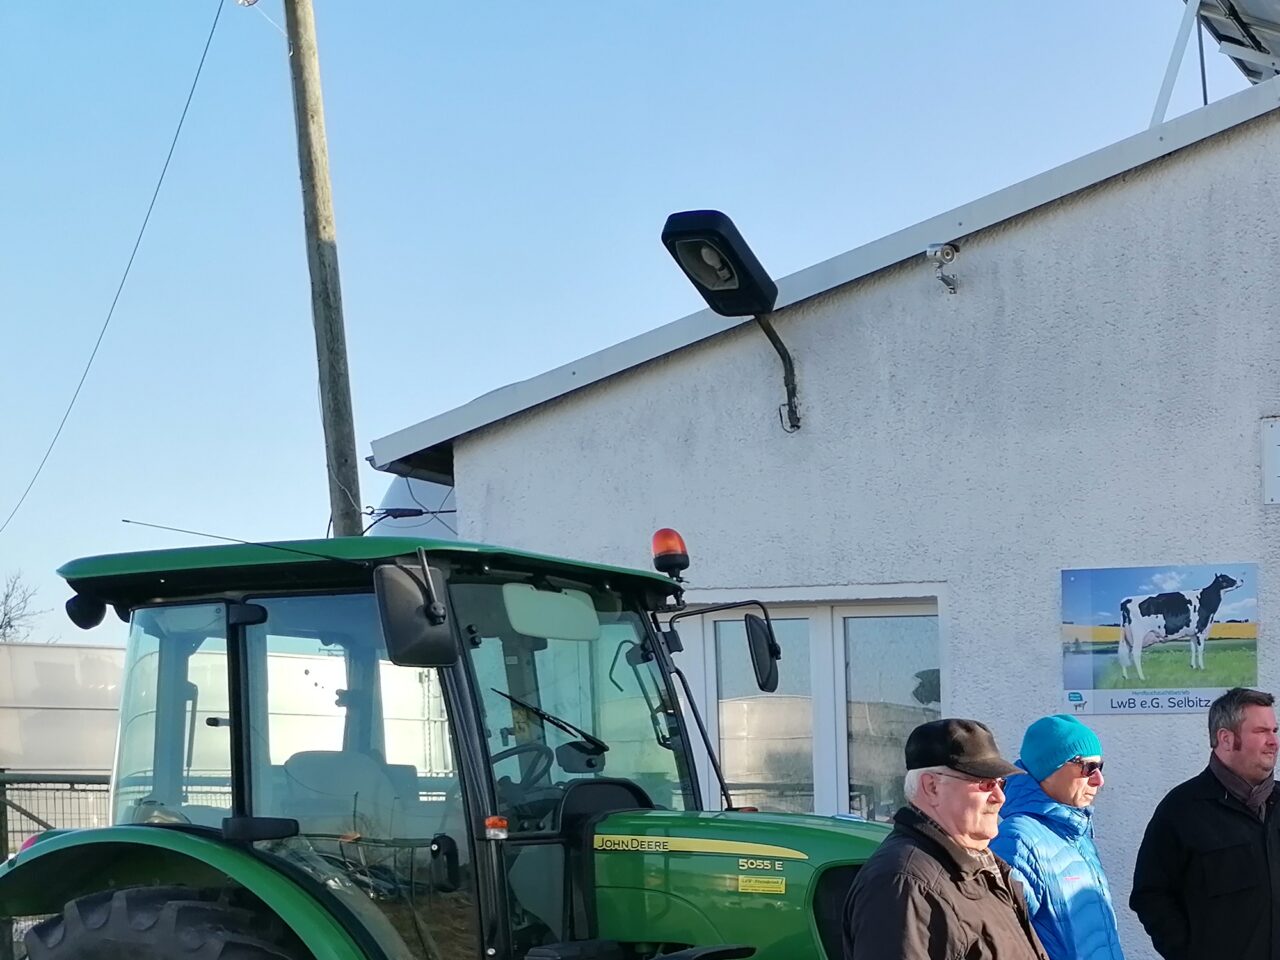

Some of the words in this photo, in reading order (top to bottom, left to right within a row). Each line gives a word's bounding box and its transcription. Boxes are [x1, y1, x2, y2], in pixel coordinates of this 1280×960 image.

[1110, 697, 1137, 708] LwB
[1140, 697, 1164, 709] e.G.
[1168, 696, 1211, 708] Selbitz
[597, 837, 629, 848] JOHN
[630, 838, 669, 850] DEERE
[738, 858, 772, 870] 5055
[775, 860, 784, 871] E
